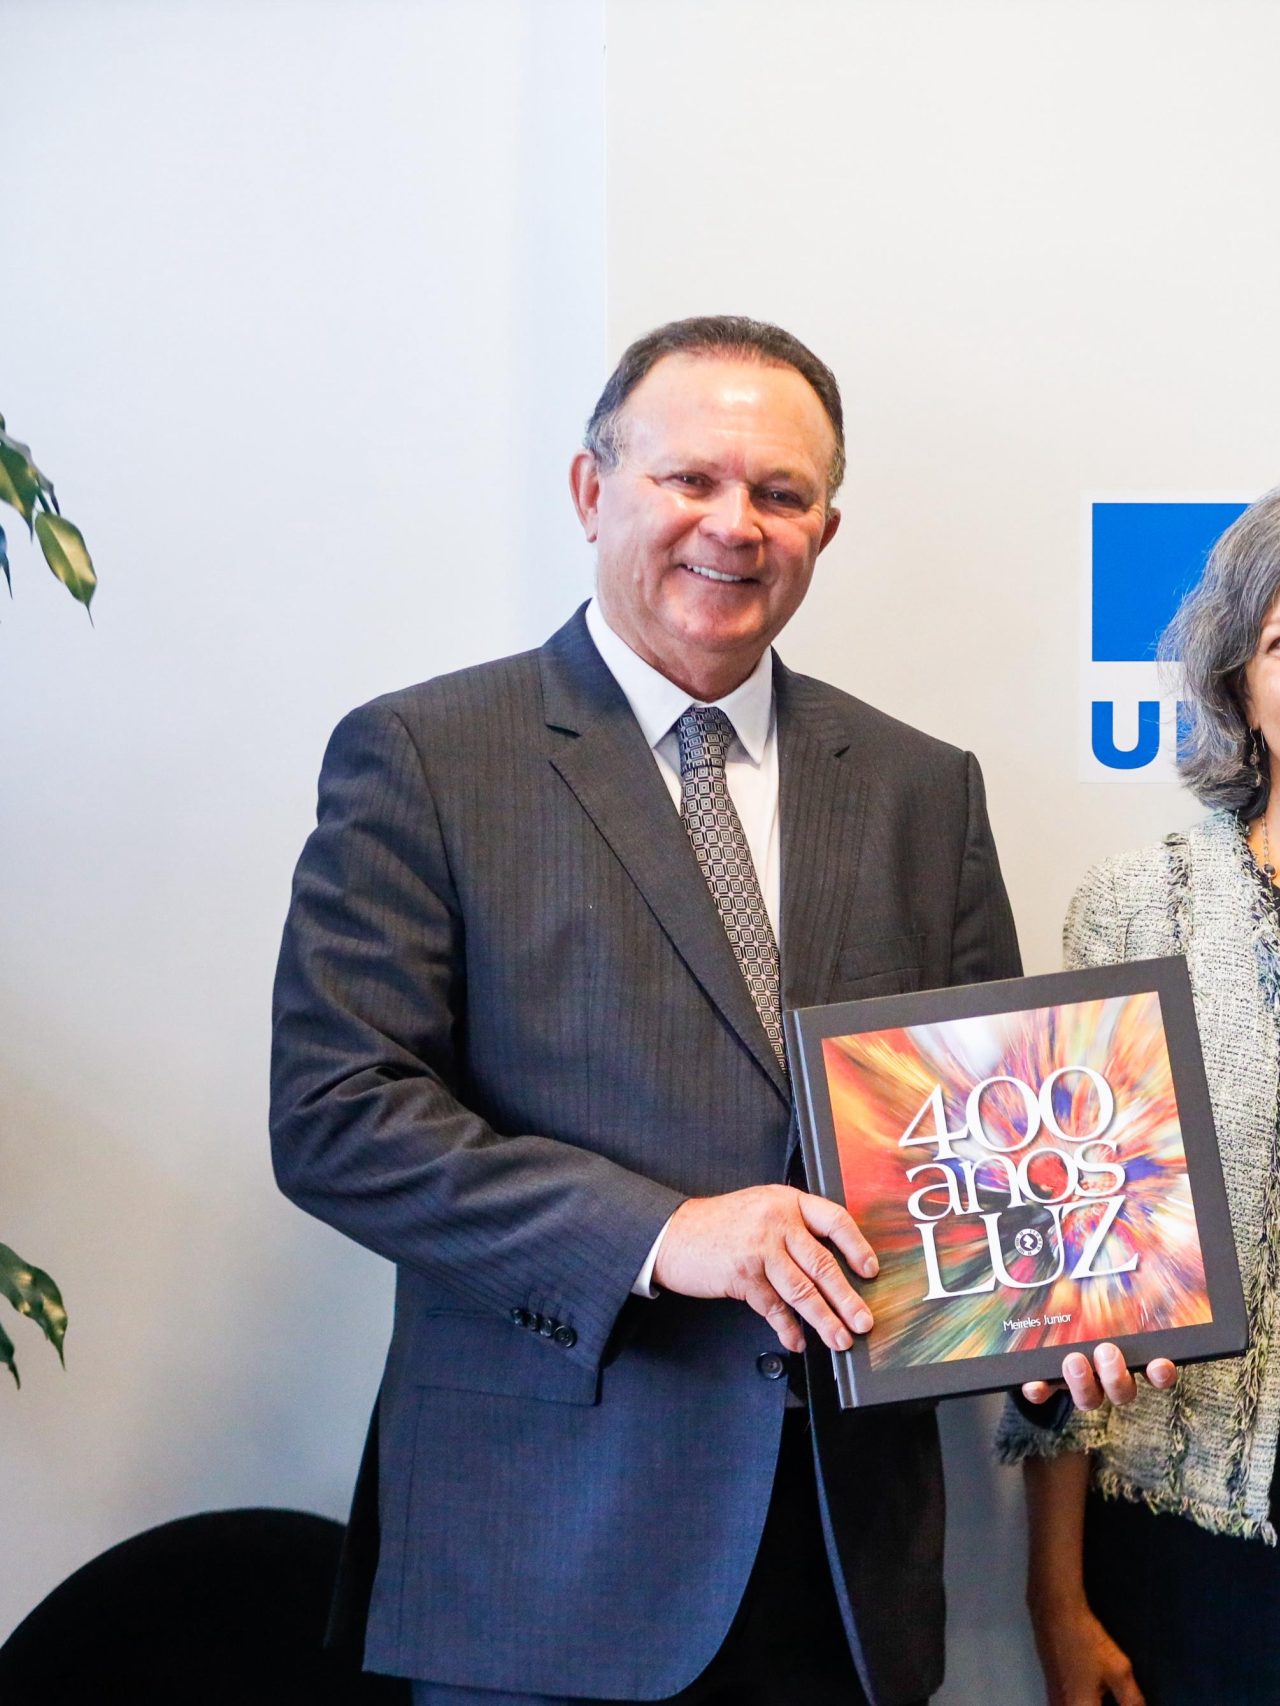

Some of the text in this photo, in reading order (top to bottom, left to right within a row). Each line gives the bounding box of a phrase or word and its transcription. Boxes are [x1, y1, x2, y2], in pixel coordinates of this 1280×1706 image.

[898, 1066, 1114, 1161] 400
[905, 1139, 1126, 1221] anos
[914, 1194, 1139, 1301] LUZ
[1003, 1313, 1072, 1331] Meireles Junior
